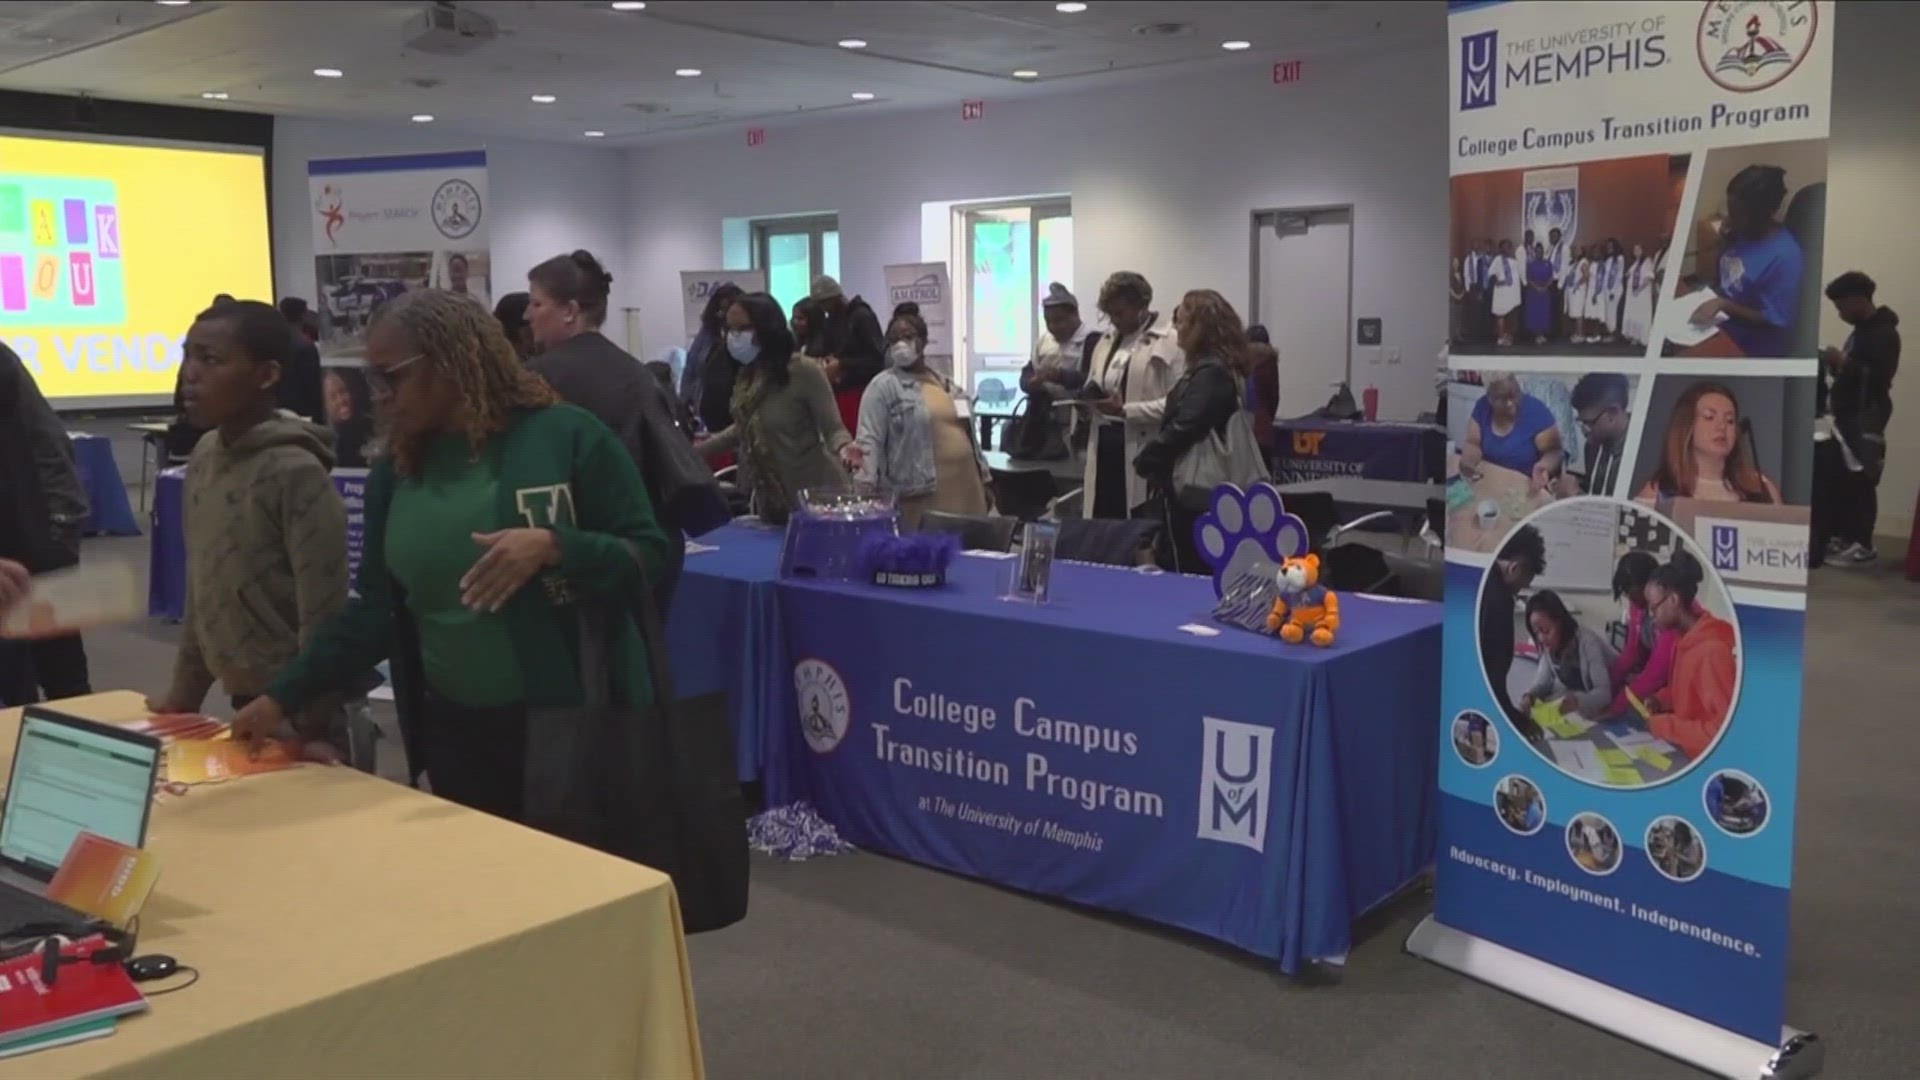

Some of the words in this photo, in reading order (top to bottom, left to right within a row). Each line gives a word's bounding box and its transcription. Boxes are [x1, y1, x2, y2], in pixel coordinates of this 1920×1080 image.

[1505, 35, 1667, 89] MEMPHIS
[1506, 40, 1536, 56] THE
[1540, 21, 1637, 52] UNIVERSITY
[1641, 16, 1667, 33] OF
[1273, 61, 1301, 83] EXIT
[747, 128, 765, 147] EXIT
[1458, 136, 1518, 157] College
[1522, 127, 1596, 149] Campus
[1601, 116, 1702, 142] Transition
[1710, 103, 1810, 131] Program
[893, 677, 996, 731] College
[1013, 696, 1138, 757] Campus
[871, 723, 1009, 786] Transition
[1026, 752, 1164, 818] Program
[918, 795, 931, 811] at
[934, 796, 955, 817] The
[958, 803, 1022, 835] University
[1024, 816, 1039, 836] of
[1042, 819, 1104, 852] Memphis
[1449, 845, 1521, 880] Advocacy.
[1525, 869, 1626, 914] Employment.
[1631, 902, 1761, 958] Independence.
